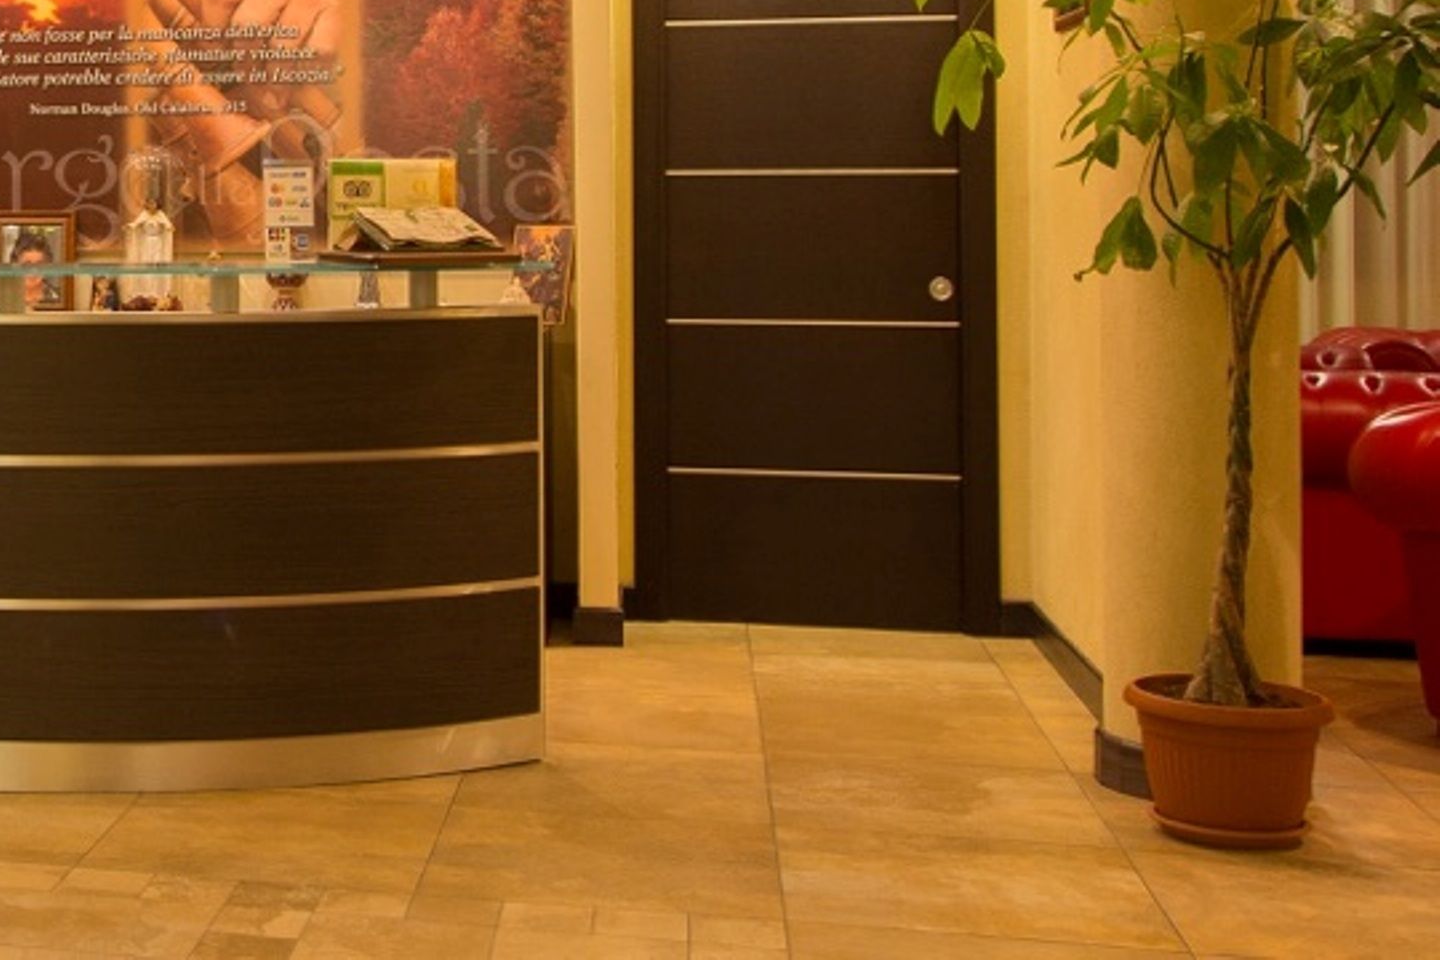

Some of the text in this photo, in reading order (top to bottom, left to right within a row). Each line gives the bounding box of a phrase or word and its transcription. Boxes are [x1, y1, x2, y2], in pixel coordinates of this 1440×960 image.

[10, 29, 42, 43] non
[44, 25, 85, 45] fosse
[87, 28, 113, 45] per
[118, 24, 133, 40] la
[136, 26, 221, 40] mancanza
[13, 51, 40, 65] sue
[44, 46, 157, 65] caratteristiche
[42, 68, 112, 89] potrebbe
[115, 67, 172, 86] credere
[174, 68, 192, 85] di
[249, 67, 267, 83] in
[29, 102, 79, 116] Norman
[134, 101, 157, 115] Old
[263, 113, 572, 224] Pta
